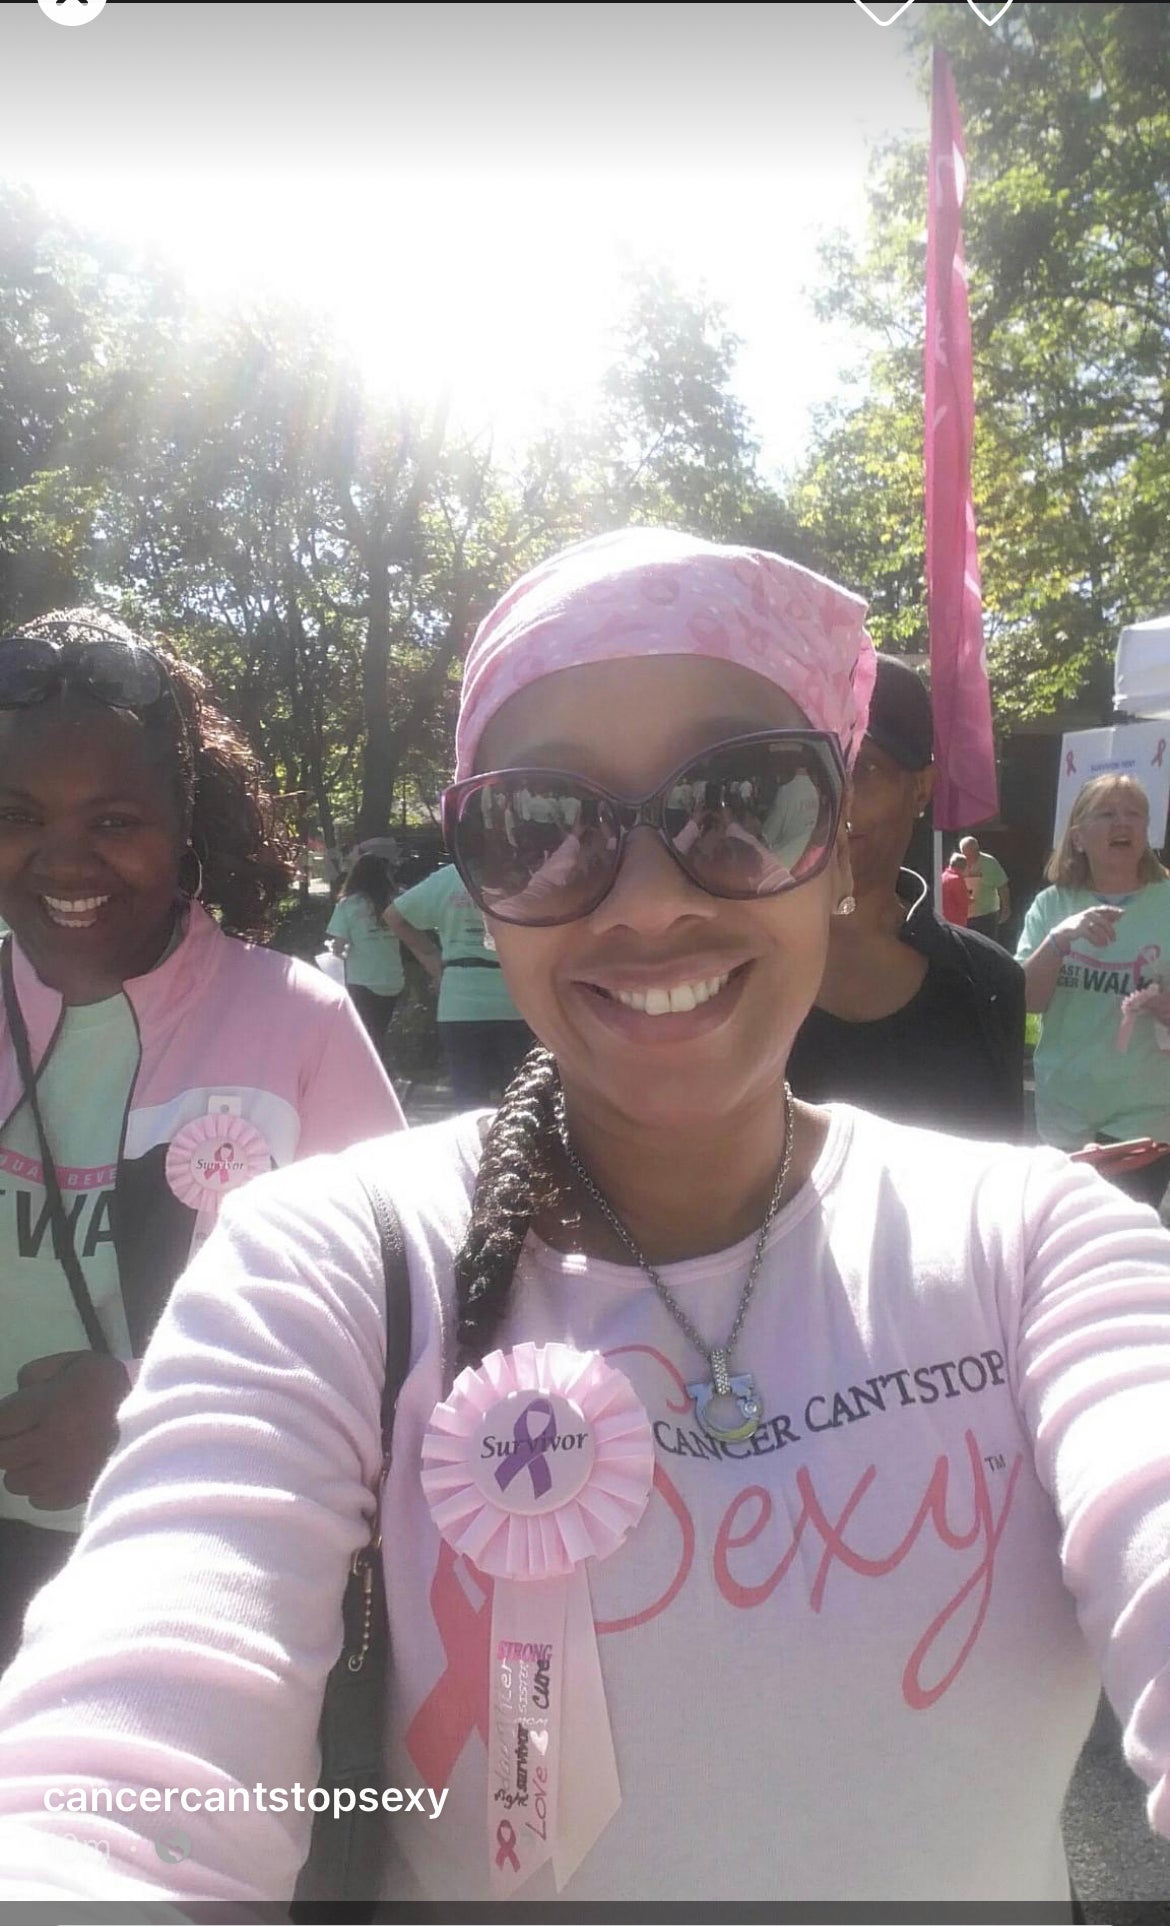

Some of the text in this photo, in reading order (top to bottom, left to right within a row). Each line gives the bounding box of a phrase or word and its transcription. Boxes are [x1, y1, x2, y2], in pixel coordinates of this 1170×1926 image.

[195, 1157, 244, 1171] Survivor
[480, 1432, 589, 1459] Survivor
[653, 1415, 801, 1461] CANCER
